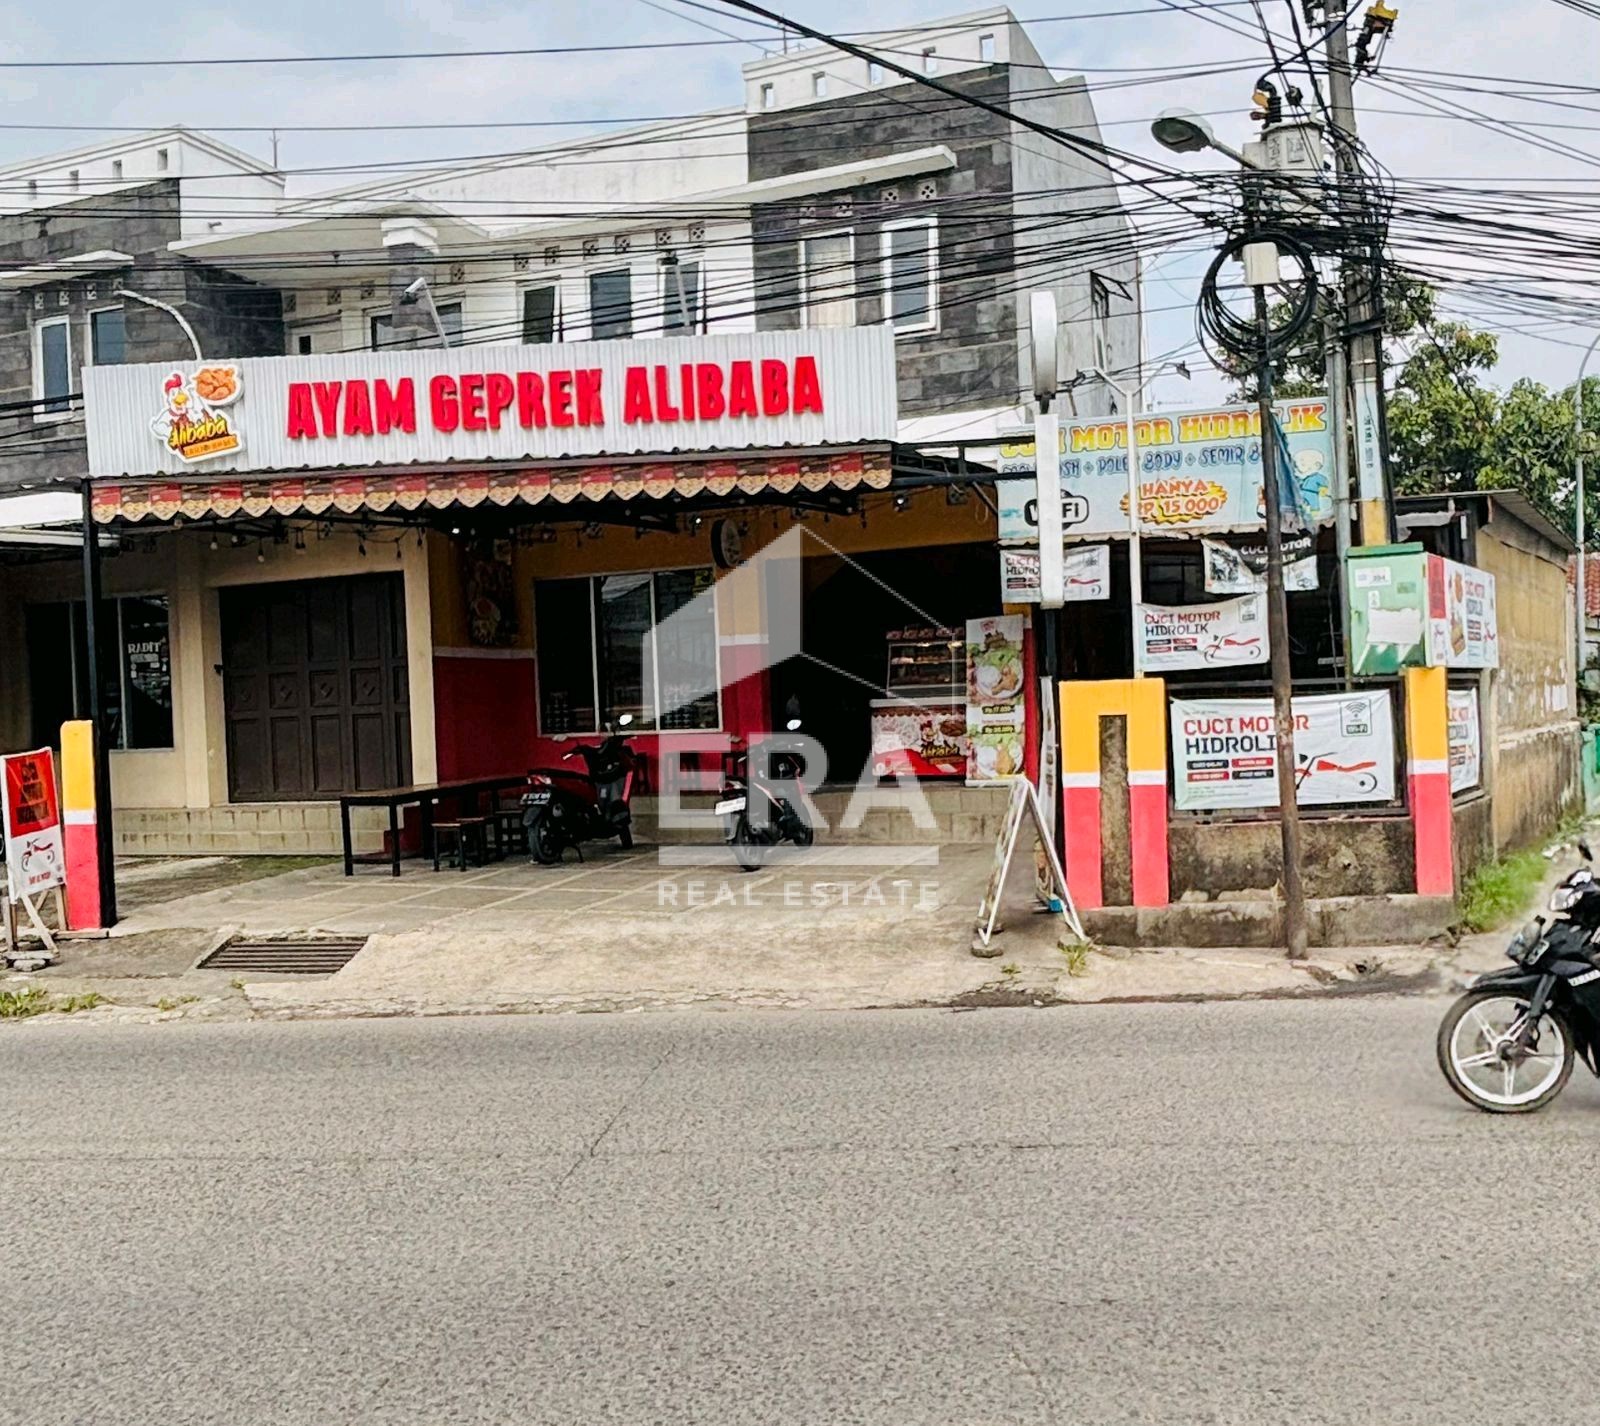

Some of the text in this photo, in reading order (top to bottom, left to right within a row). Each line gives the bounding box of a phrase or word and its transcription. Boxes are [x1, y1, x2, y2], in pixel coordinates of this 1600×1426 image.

[287, 355, 823, 439] AYAM GEPREK ALIBABA
[1070, 417, 1173, 452] MOTOR
[1178, 403, 1326, 443] HIDRIK
[1099, 457, 1128, 474] POLE
[1142, 451, 1182, 470] BODY
[1200, 446, 1244, 465] SEMIR
[1142, 480, 1208, 497] HANYA
[1280, 537, 1311, 552] OTOR
[1144, 611, 1221, 625] CUCI MOTOR
[1146, 623, 1209, 637] HIDROLIK
[1184, 714, 1310, 736] CUCI MOTR
[1186, 734, 1277, 755] HIDROLI
